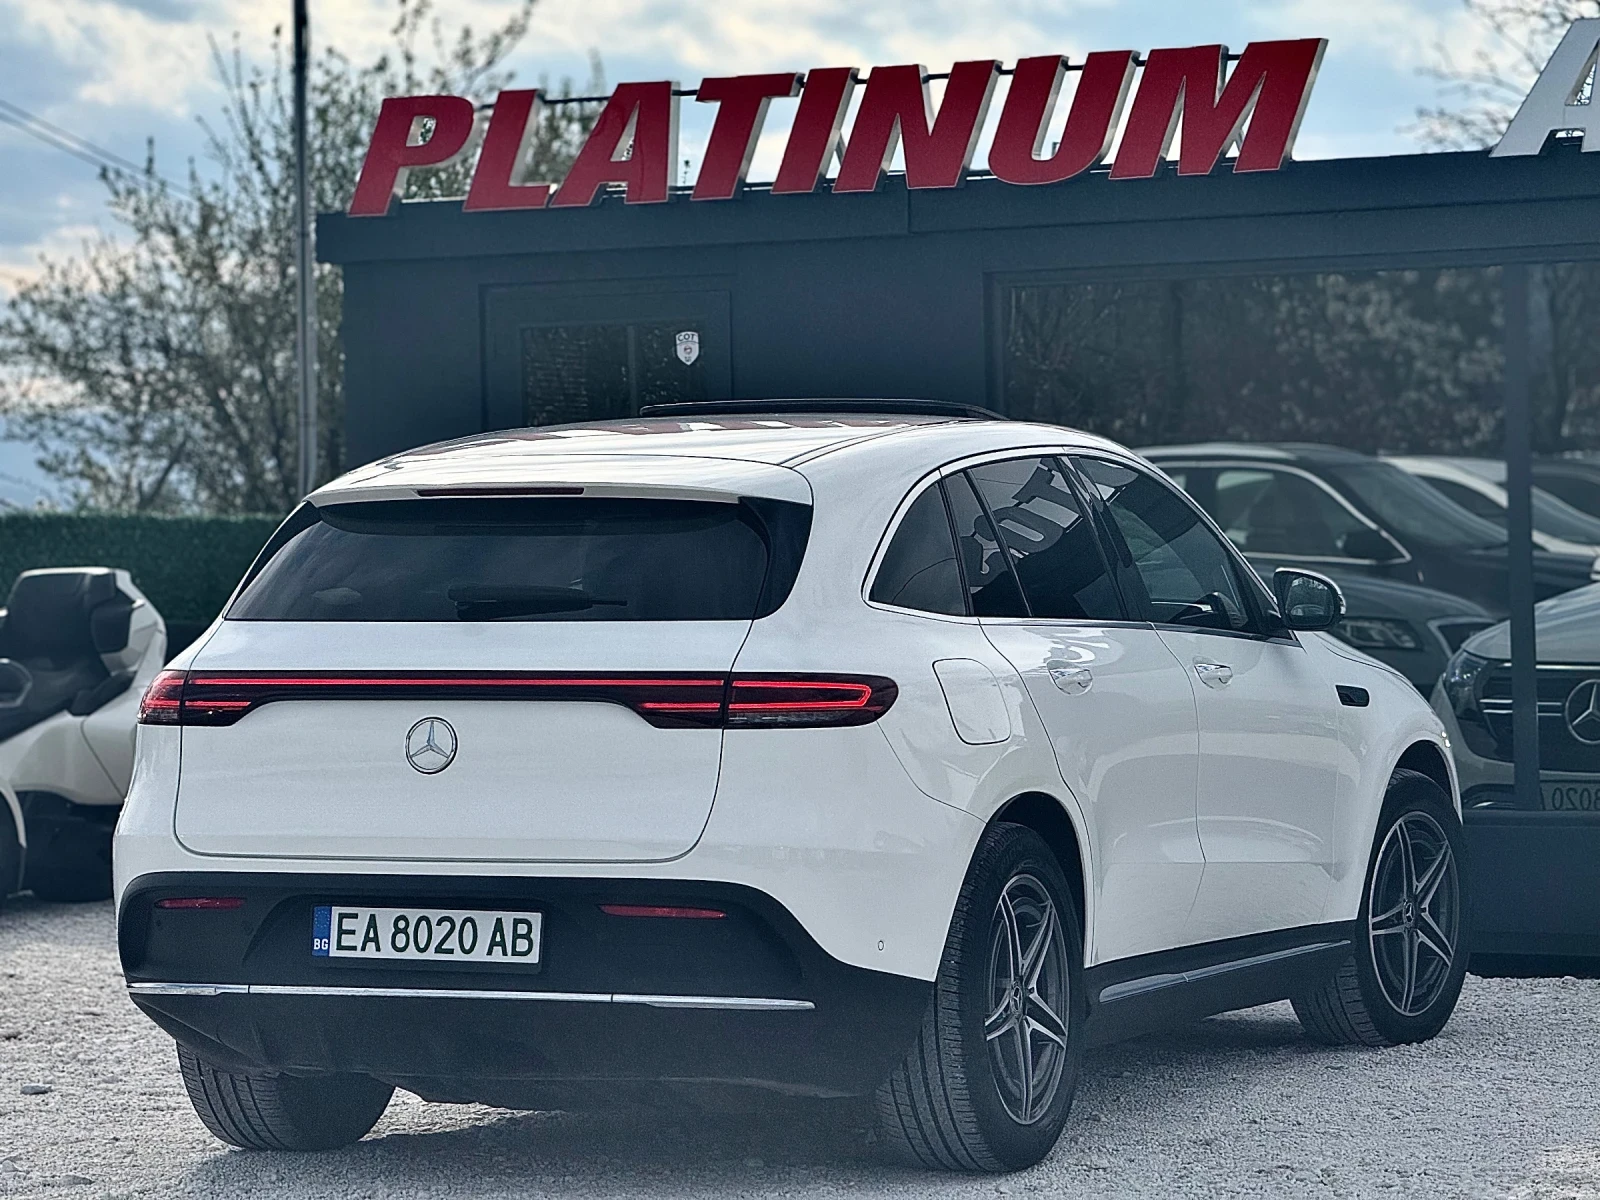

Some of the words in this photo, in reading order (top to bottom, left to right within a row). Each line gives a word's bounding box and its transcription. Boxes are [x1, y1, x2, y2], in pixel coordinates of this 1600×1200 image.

[349, 38, 1328, 217] PLATINUM
[313, 938, 329, 950] BG
[335, 912, 381, 952] EA
[390, 914, 478, 955] 8020
[486, 917, 534, 957] AB
